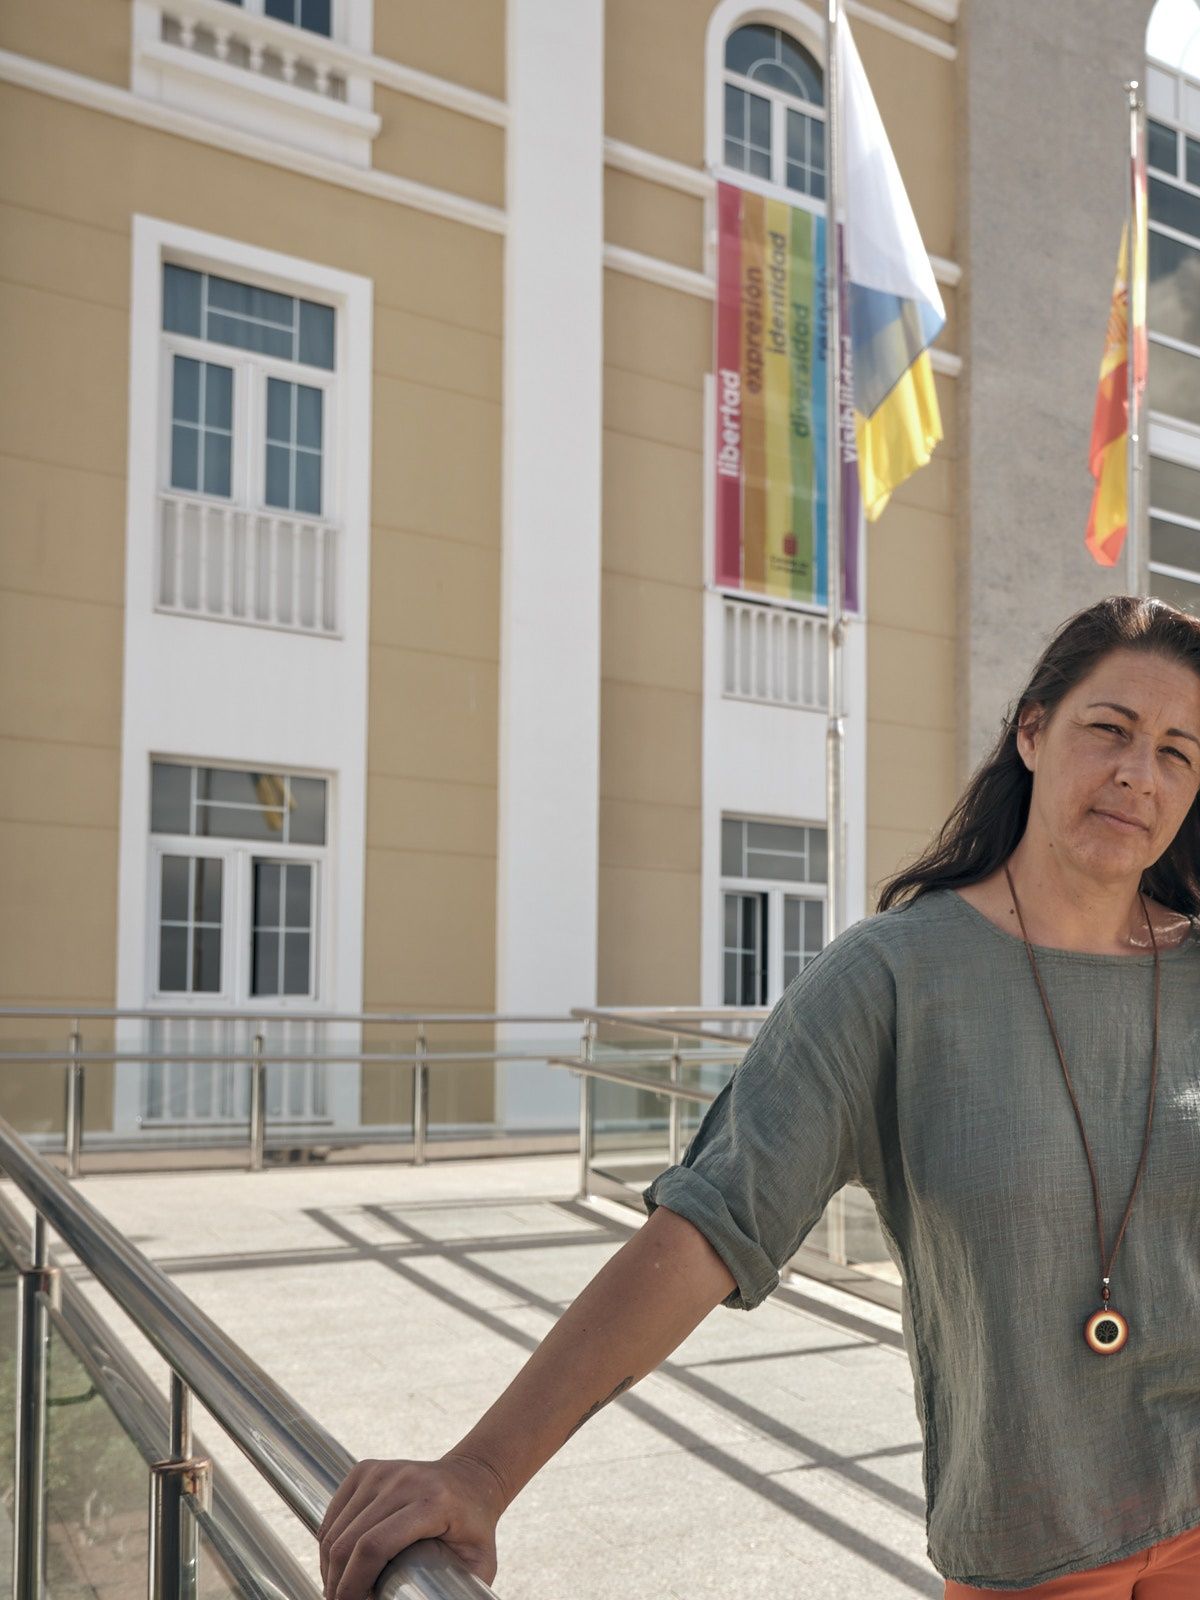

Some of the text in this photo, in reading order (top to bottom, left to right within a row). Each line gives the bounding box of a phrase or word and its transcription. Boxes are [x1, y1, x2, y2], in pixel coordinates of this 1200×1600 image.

[745, 265, 764, 395] expresión
[768, 230, 787, 356] identidad
[717, 369, 741, 478] libertad
[791, 303, 812, 439] diversidad
